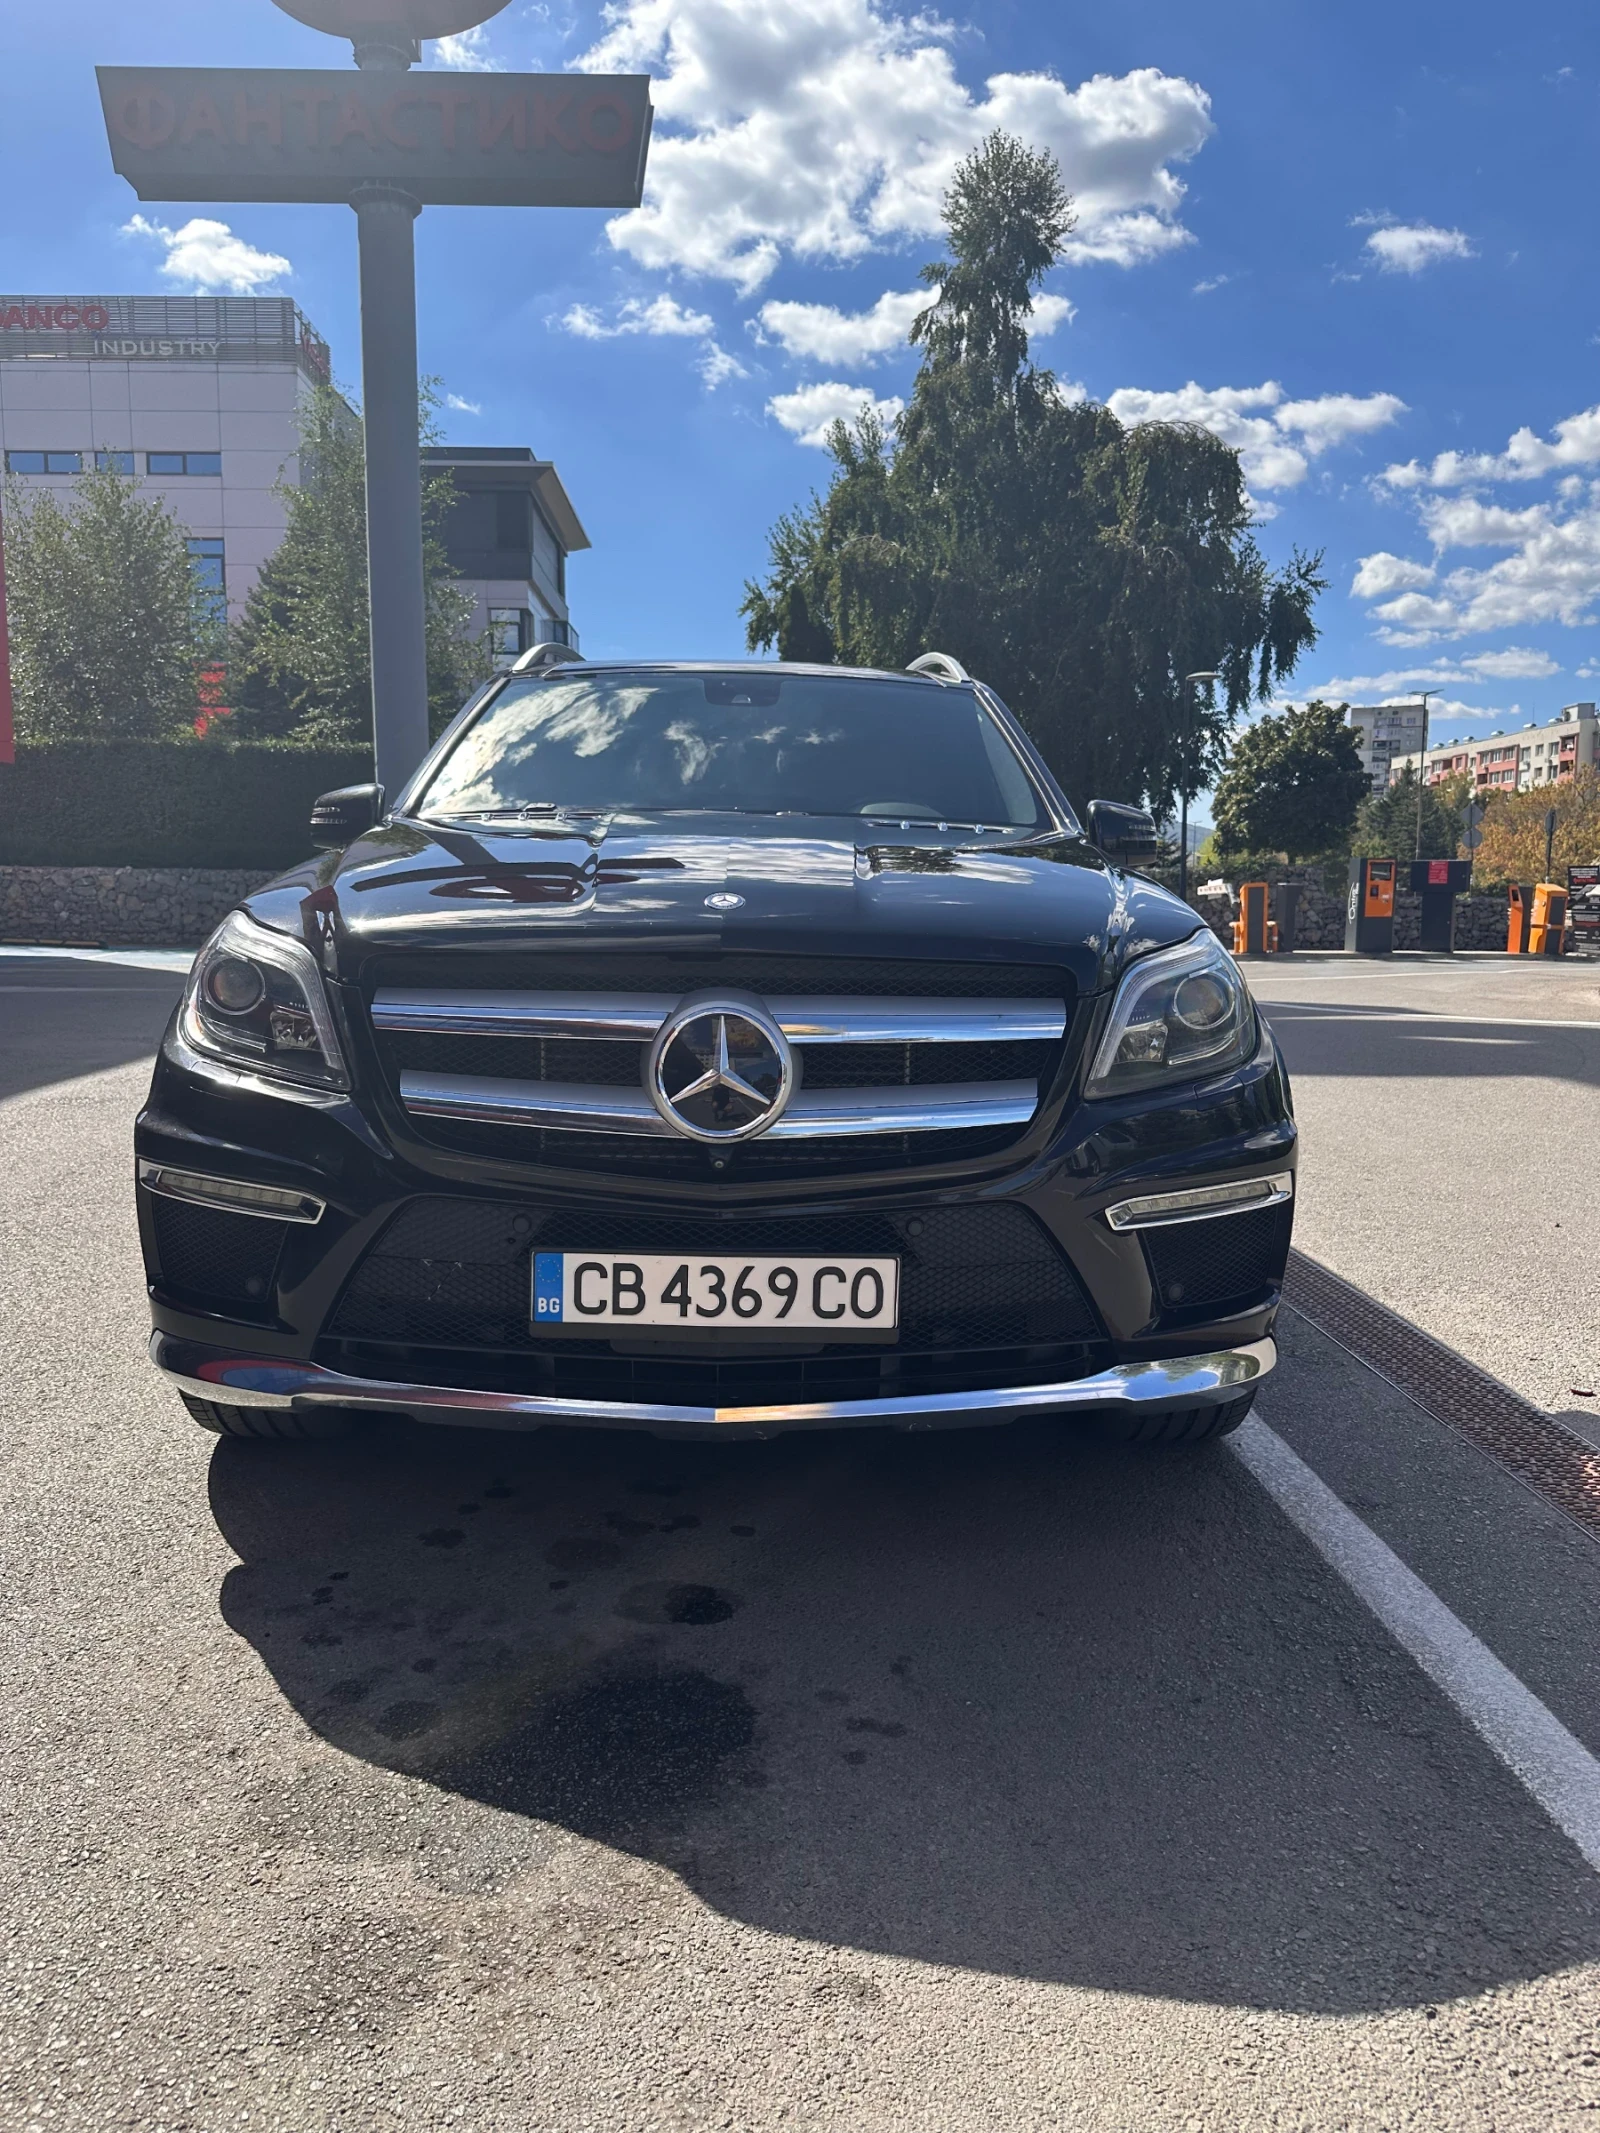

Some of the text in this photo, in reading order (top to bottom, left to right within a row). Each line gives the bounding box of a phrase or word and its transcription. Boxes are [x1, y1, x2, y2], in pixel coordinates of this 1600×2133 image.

[111, 83, 634, 152] ФАНТАСТИКО
[0, 304, 109, 330] ANCO
[94, 339, 222, 355] INDUSTRY
[573, 1261, 884, 1319] CB 4369 CO
[537, 1297, 560, 1314] BG
